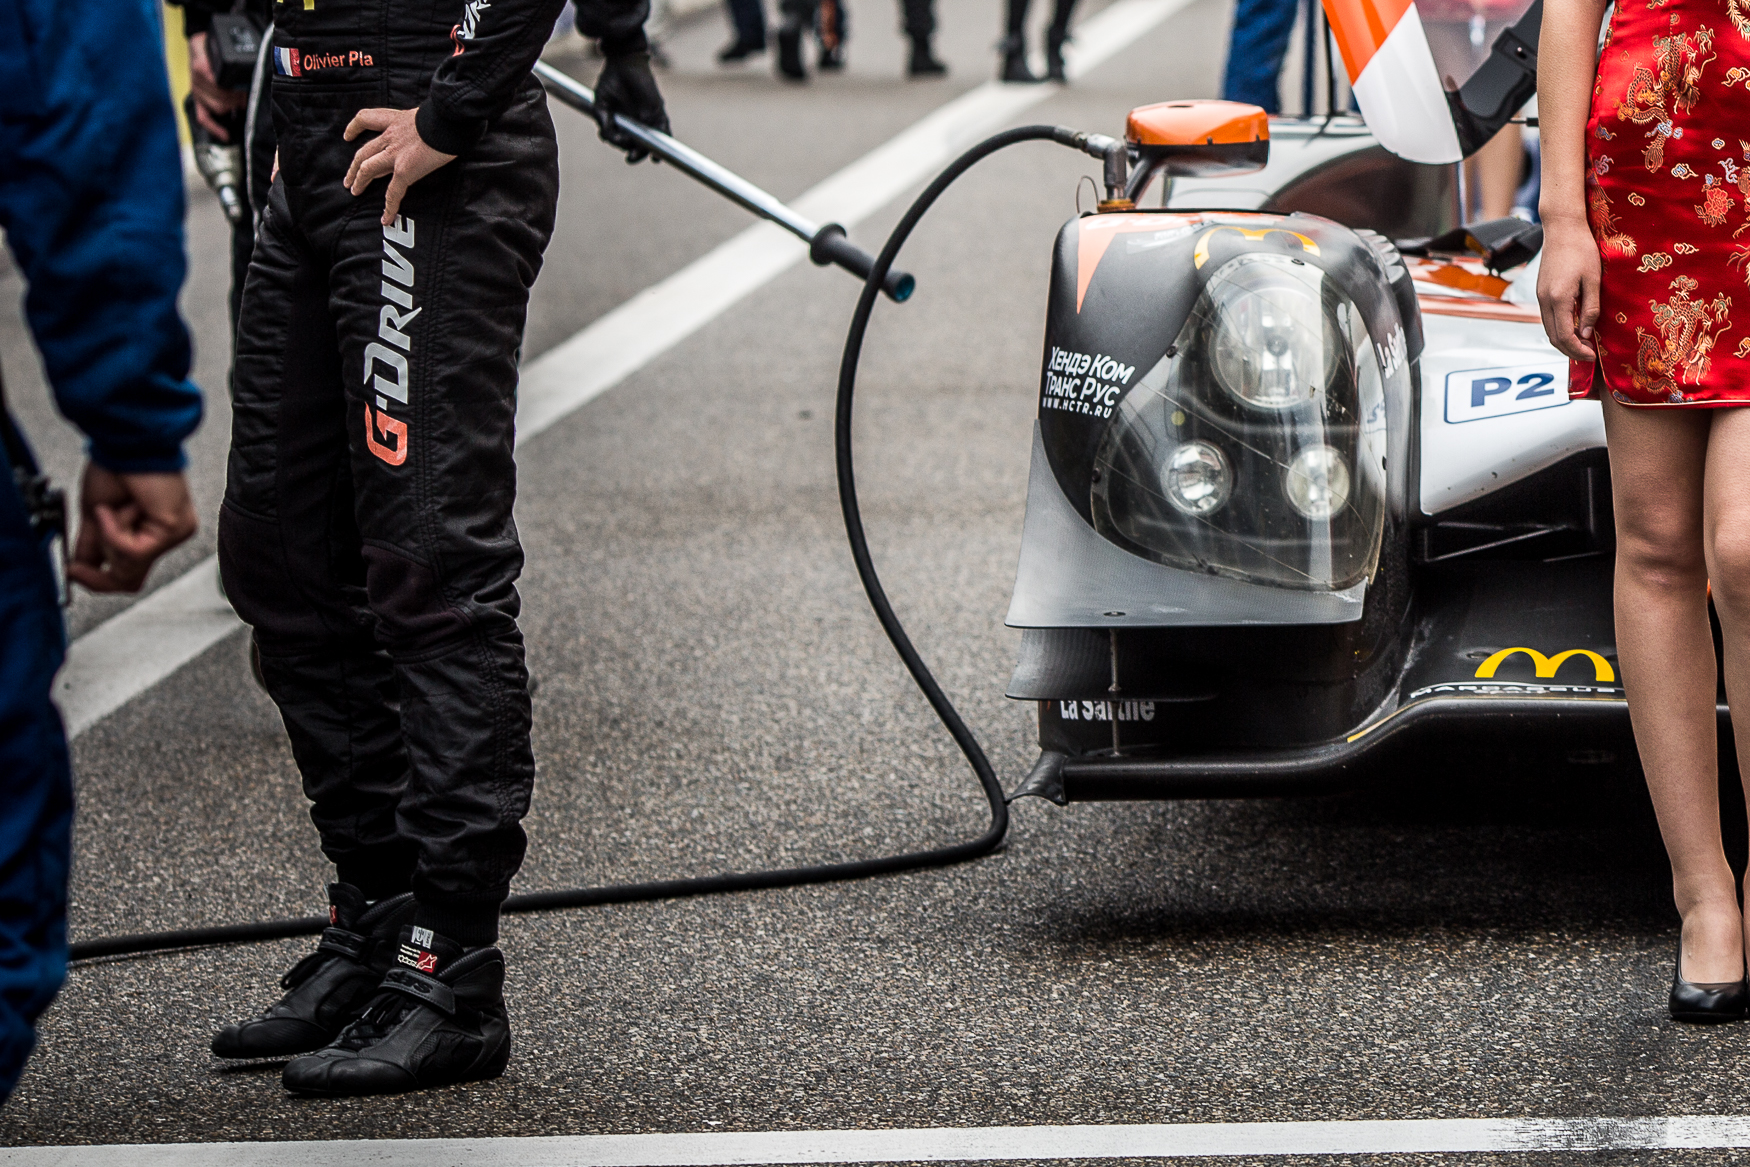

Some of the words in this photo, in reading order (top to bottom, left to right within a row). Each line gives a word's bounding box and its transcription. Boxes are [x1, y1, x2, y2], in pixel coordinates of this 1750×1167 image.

[303, 53, 346, 71] Olivier
[348, 50, 374, 67] Pla
[363, 214, 422, 466] G-DRIVE
[1470, 372, 1555, 408] P2
[1060, 700, 1079, 720] La
